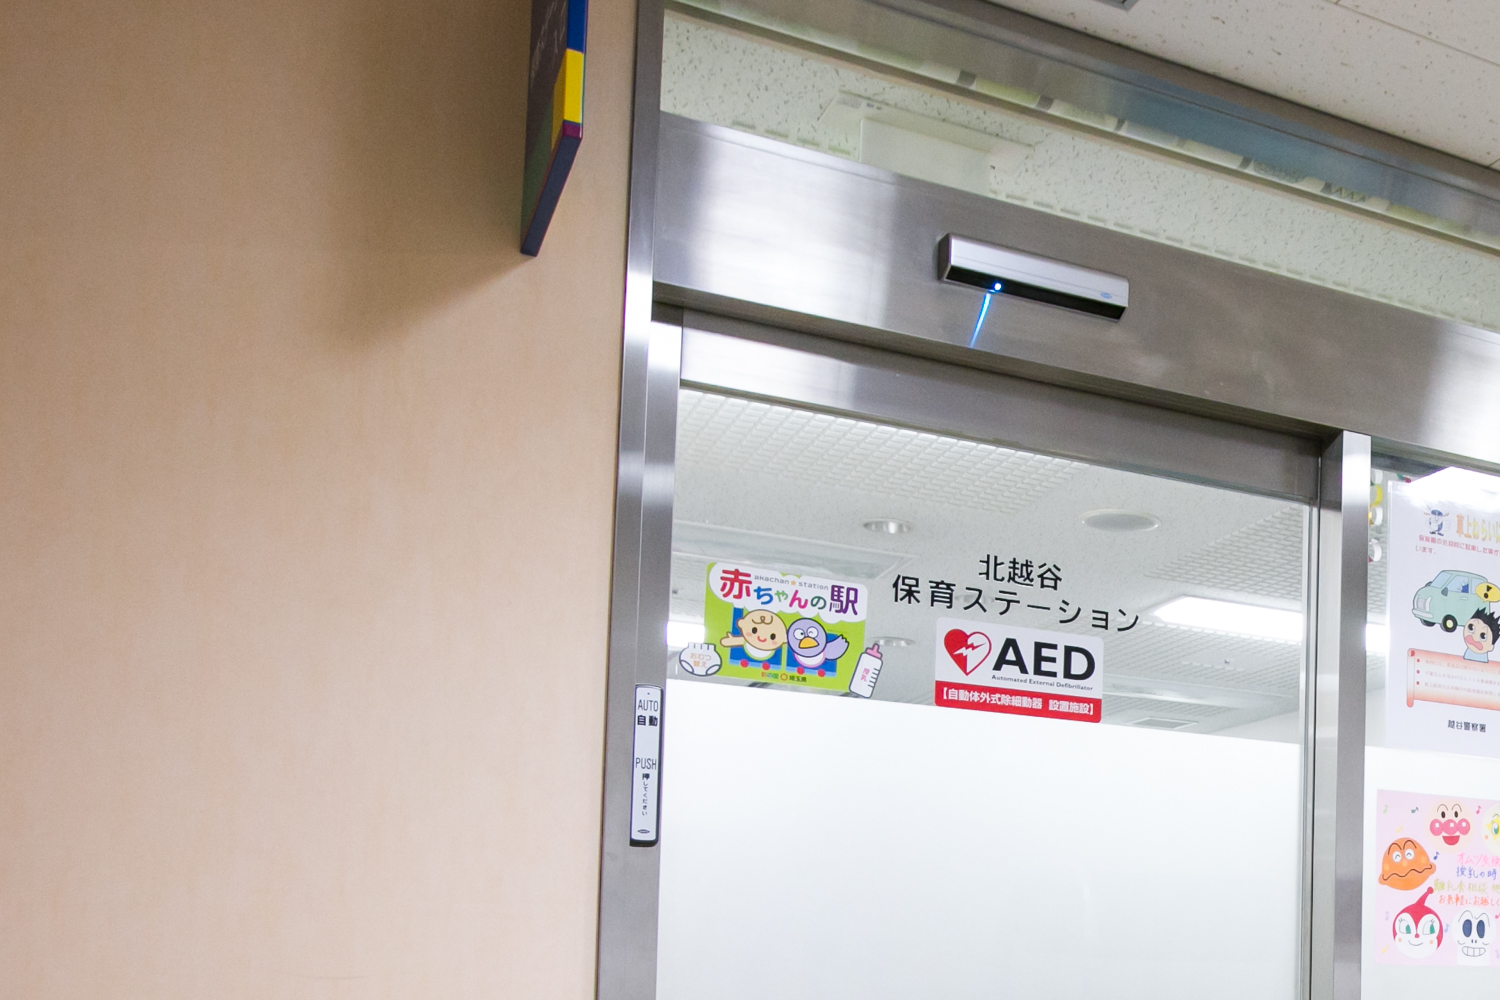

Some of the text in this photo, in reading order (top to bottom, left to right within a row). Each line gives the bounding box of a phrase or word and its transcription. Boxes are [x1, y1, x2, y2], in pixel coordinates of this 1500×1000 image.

[978, 553, 1063, 591] 北越谷
[754, 574, 829, 591] akachan station
[720, 568, 859, 616] 赤ちゃんの駅
[892, 574, 1140, 632] 保育ステーション
[690, 652, 712, 661] おむつ
[992, 637, 1096, 681] AED
[991, 674, 1094, 692] Automated External Defibrillator
[638, 699, 659, 712] AUTO
[637, 715, 658, 727] 自動
[1447, 719, 1486, 733] 越谷警察署
[636, 757, 657, 770] PUSH
[641, 773, 650, 816] 押してください
[1456, 866, 1497, 880] 授乳の時
